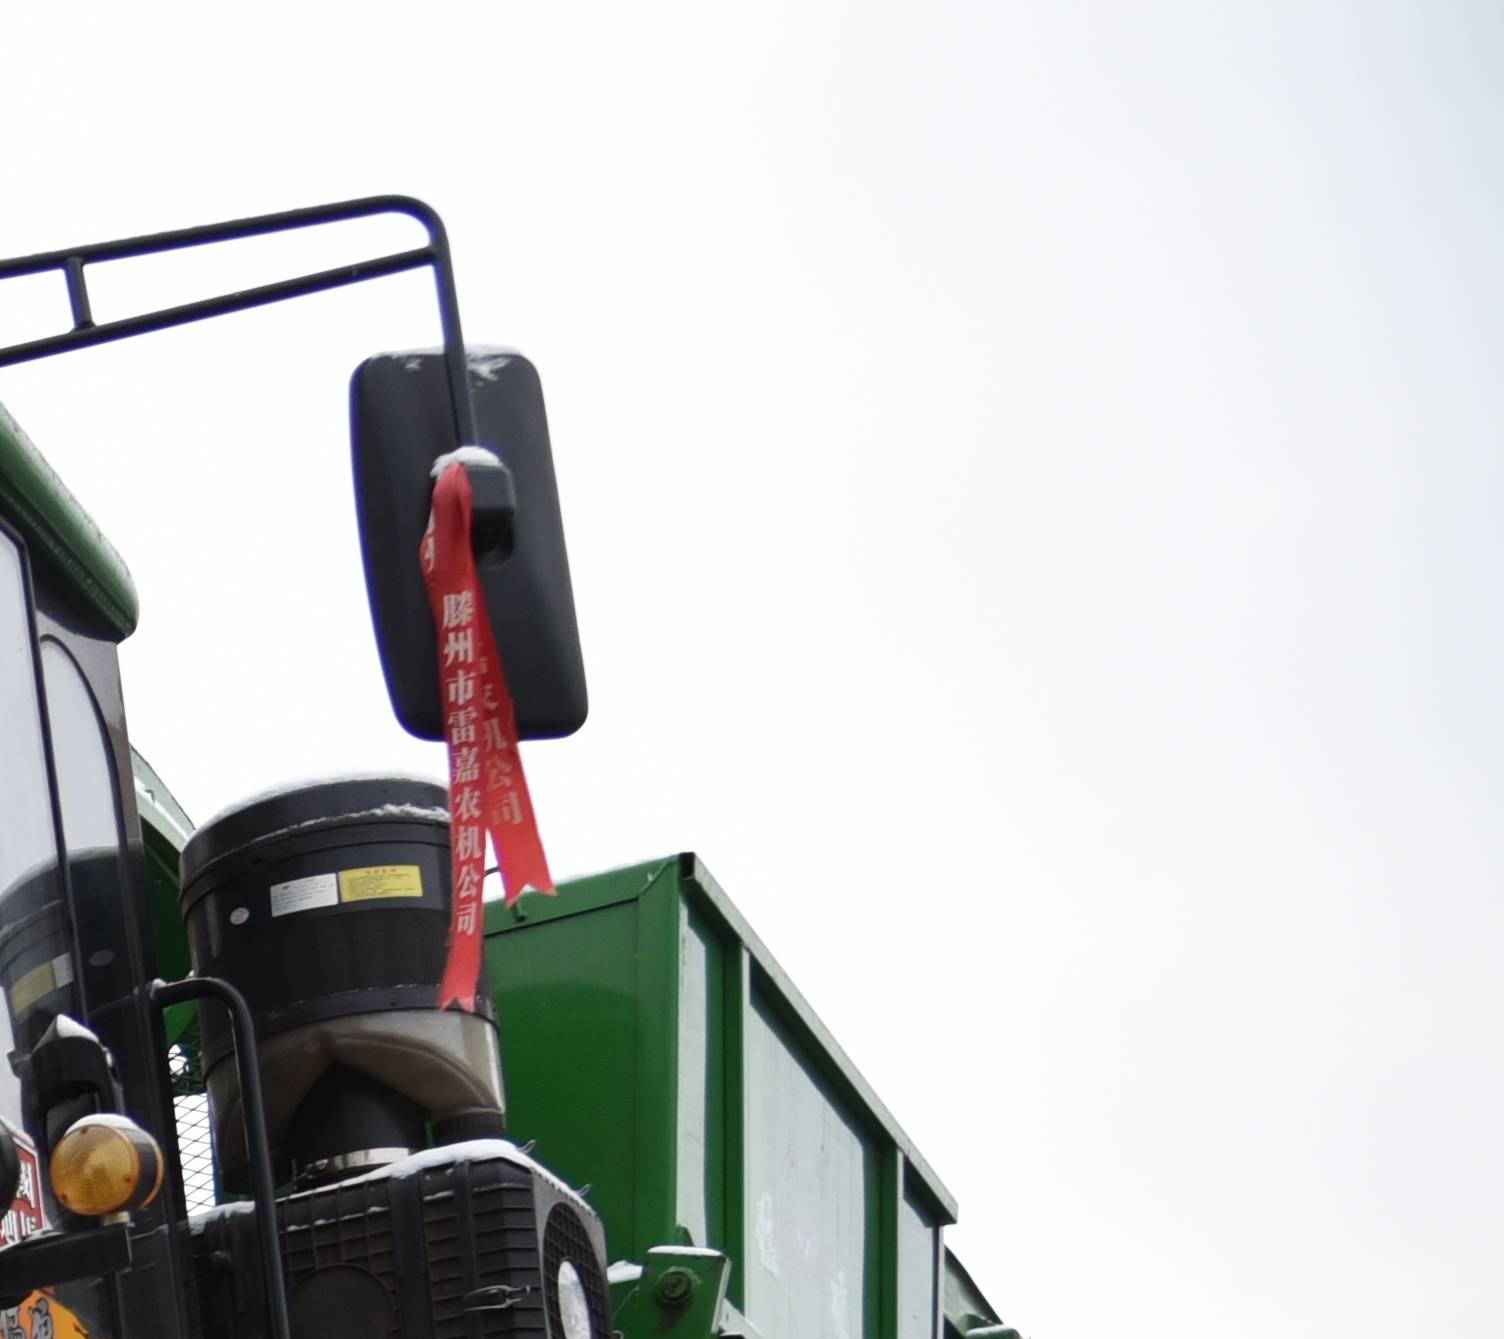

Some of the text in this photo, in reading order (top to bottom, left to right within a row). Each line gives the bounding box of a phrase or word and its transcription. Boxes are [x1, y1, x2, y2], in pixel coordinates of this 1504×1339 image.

[441, 592, 483, 936] 滕州市雷嘉农机公司
